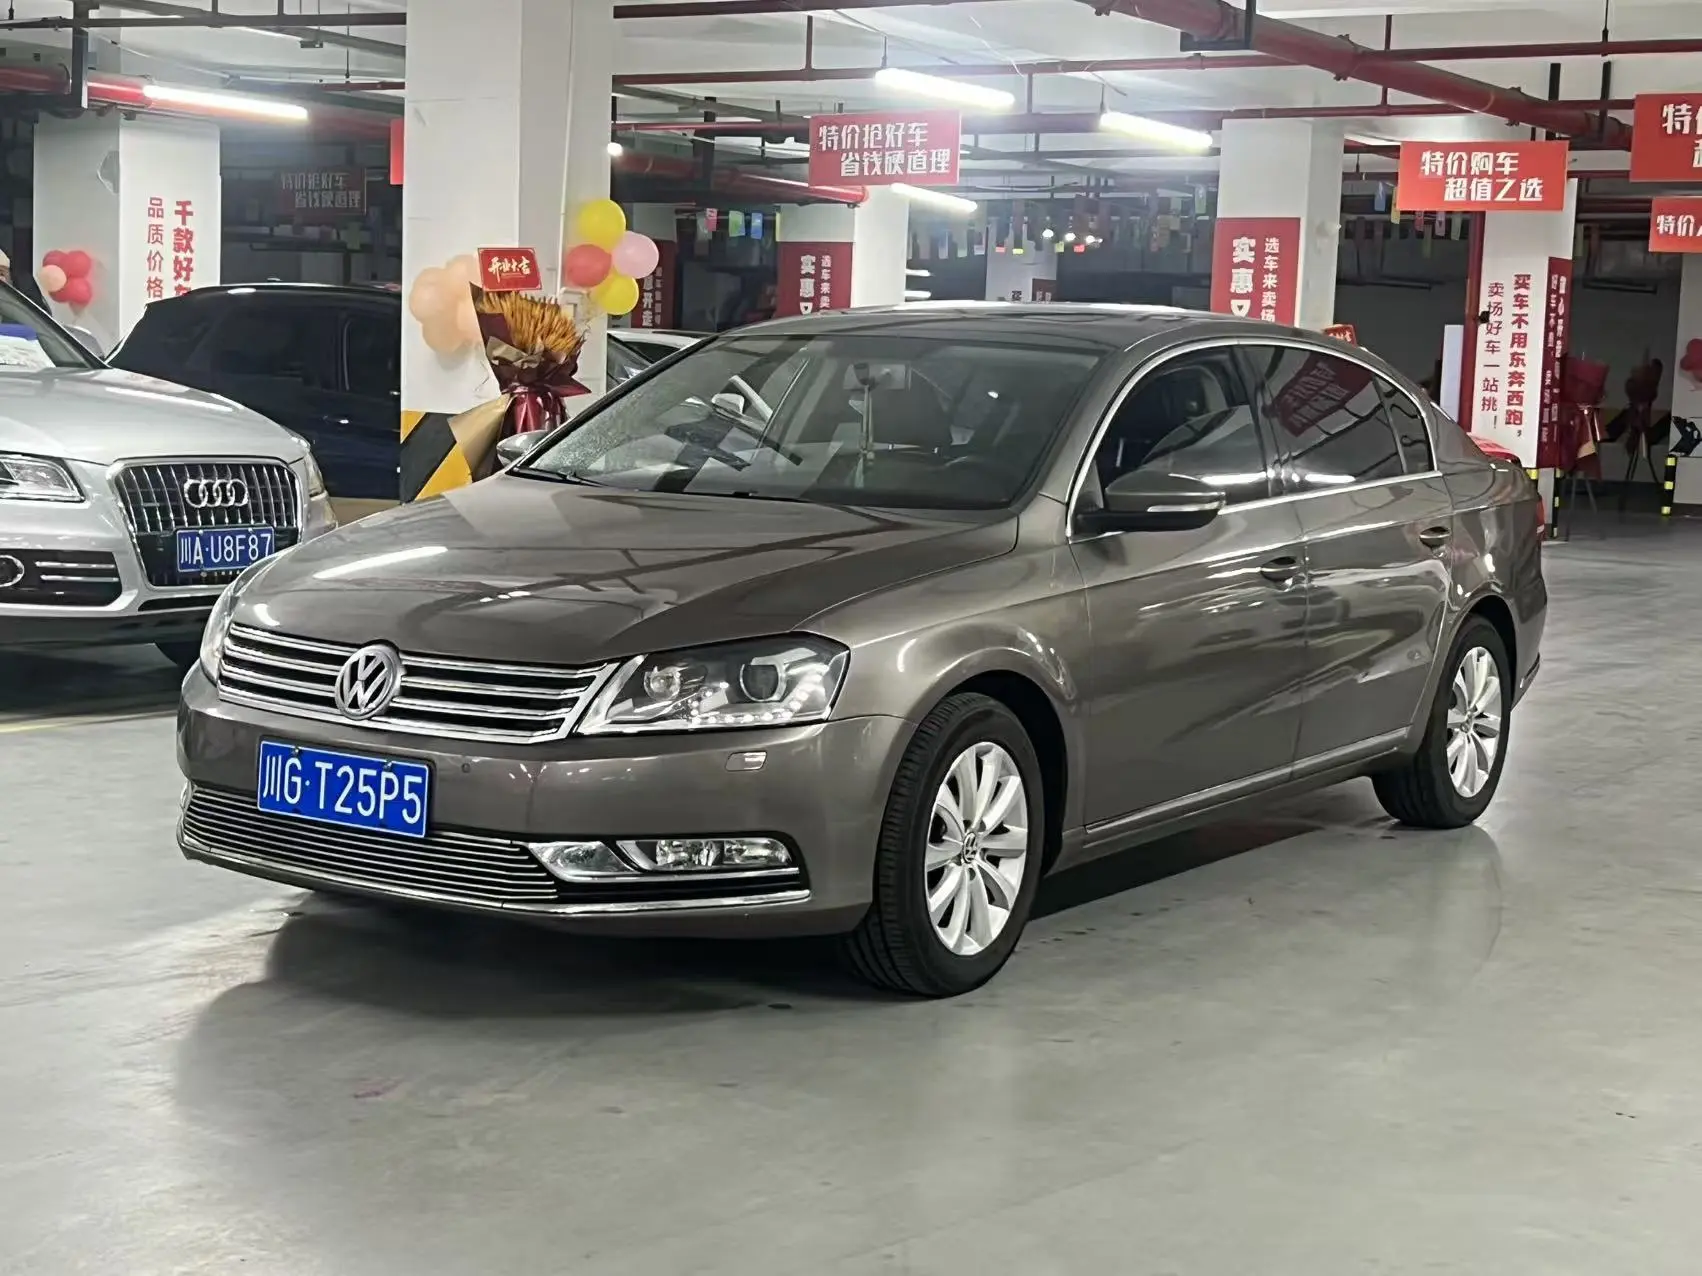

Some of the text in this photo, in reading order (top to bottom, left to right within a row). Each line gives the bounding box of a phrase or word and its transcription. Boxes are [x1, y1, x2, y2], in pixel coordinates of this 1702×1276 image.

[818, 122, 929, 152] 特价抢好车
[840, 148, 951, 177] 省钱硬道理
[1420, 150, 1520, 176] 特价购车
[1443, 177, 1544, 202] 超值之选
[146, 196, 164, 299] 品质价格
